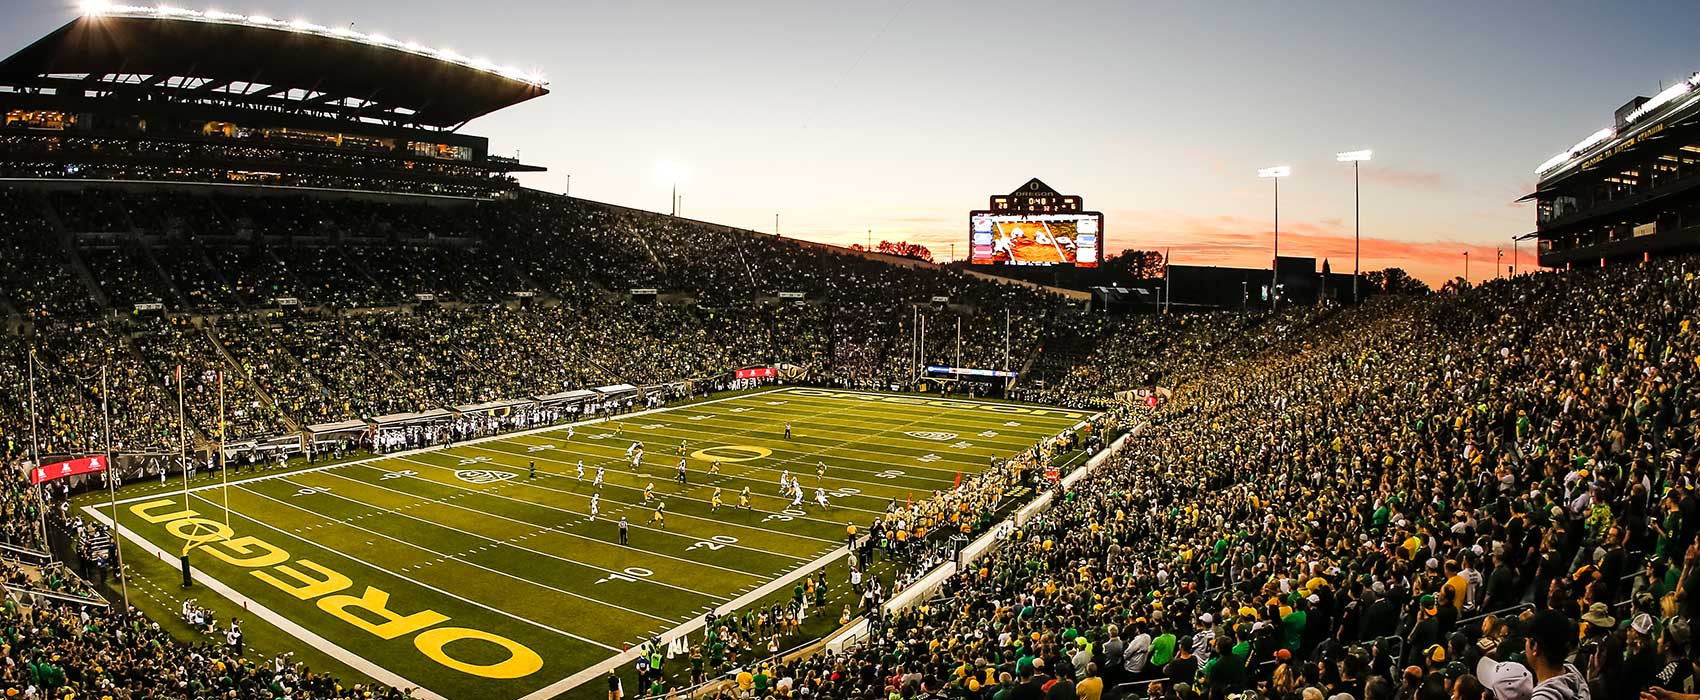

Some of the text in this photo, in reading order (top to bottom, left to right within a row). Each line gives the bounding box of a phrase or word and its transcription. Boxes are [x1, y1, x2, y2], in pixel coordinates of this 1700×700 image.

[768, 509, 807, 522] 30
[694, 535, 739, 551] 20
[607, 567, 654, 583] 10
[129, 499, 544, 679] OREGON
